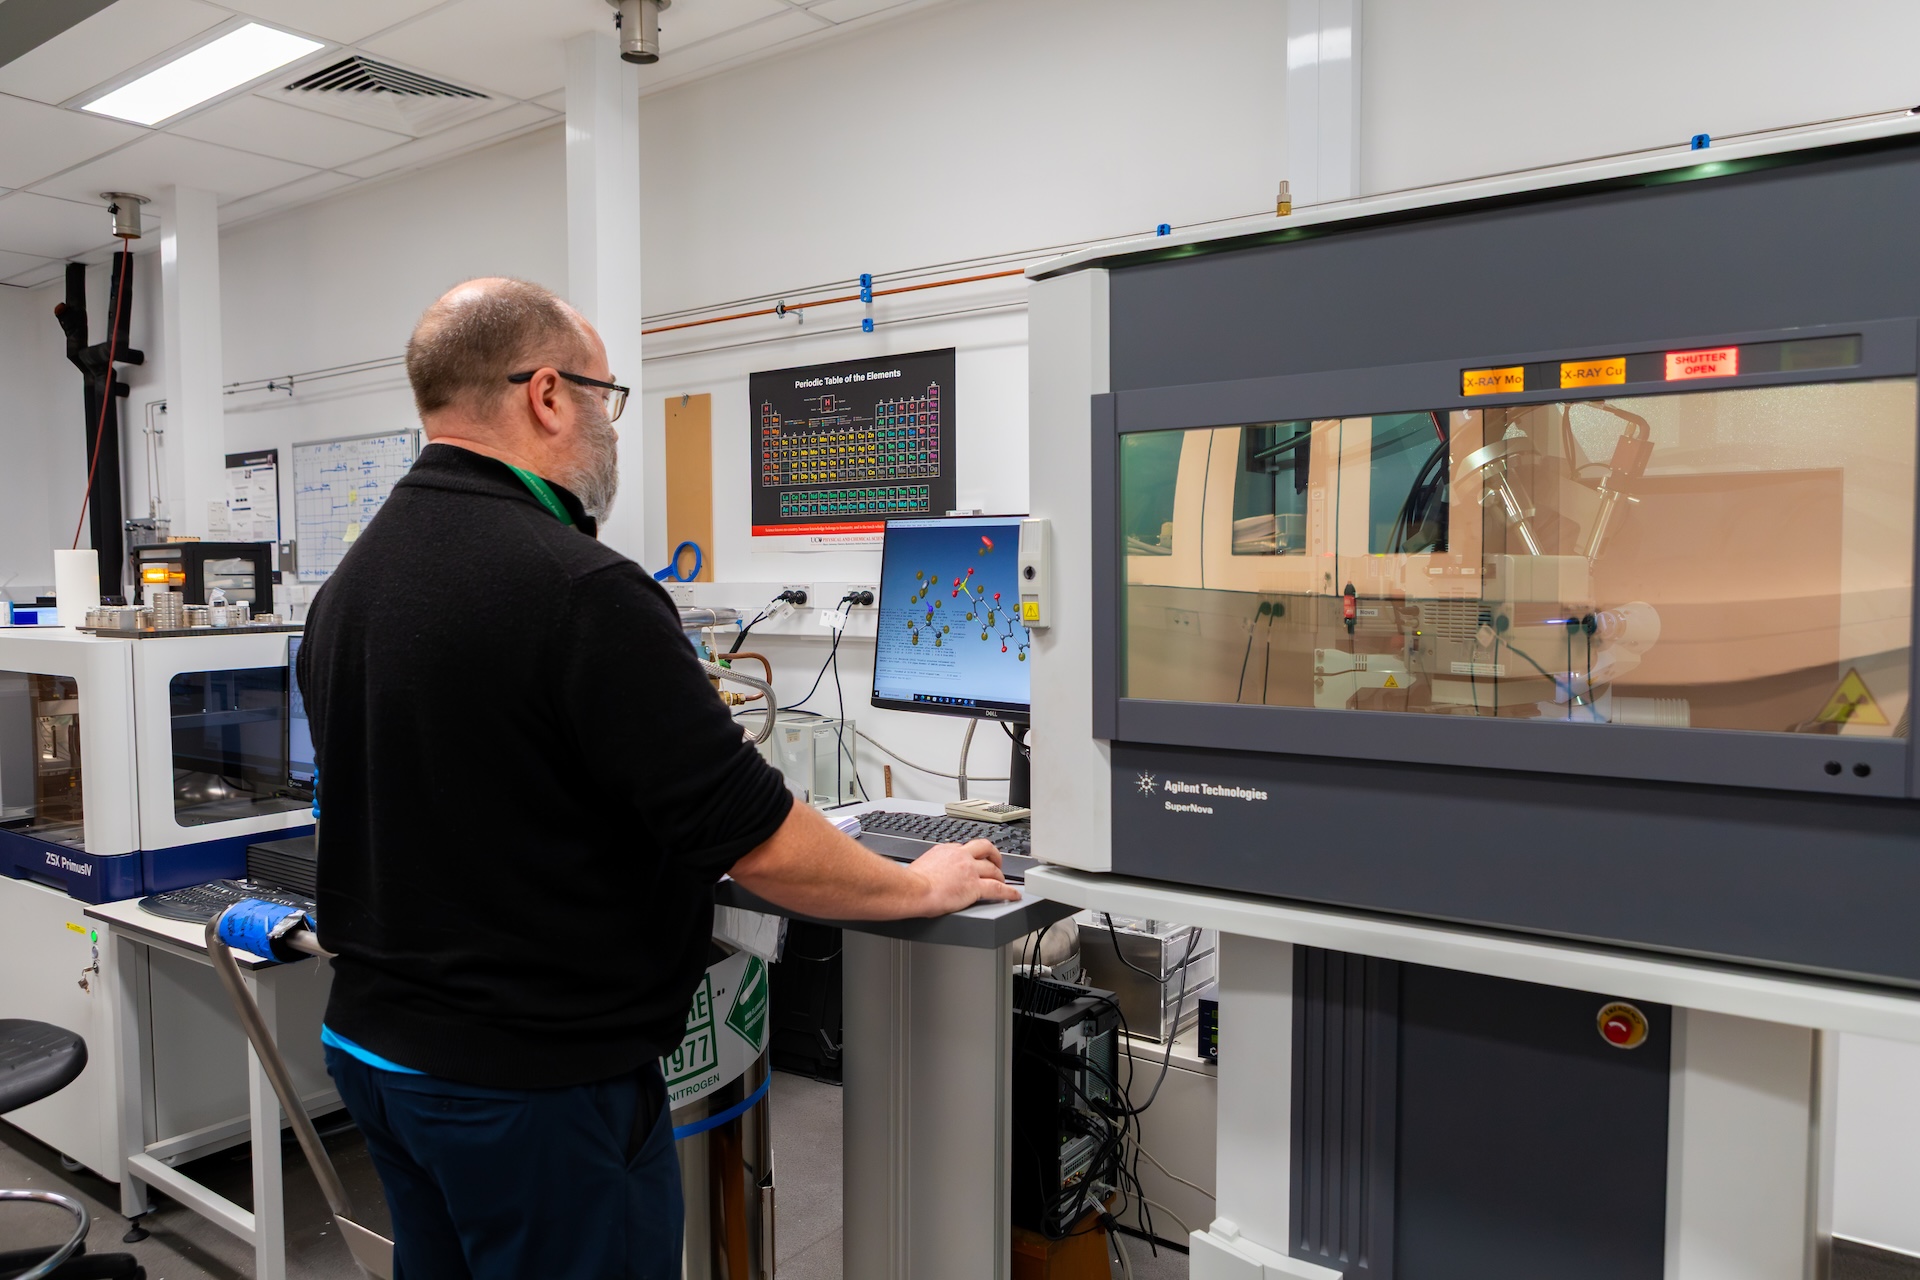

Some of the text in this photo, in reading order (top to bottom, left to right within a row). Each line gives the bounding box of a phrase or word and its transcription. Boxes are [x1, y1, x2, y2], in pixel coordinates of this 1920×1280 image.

[1675, 352, 1726, 364] SHUTTER
[1564, 367, 1622, 379] X-RAY Cu
[1685, 365, 1716, 374] OPEN
[795, 370, 901, 388] Periodic Table of the Elements
[1467, 375, 1522, 387] X-RAY Mo
[1164, 780, 1268, 801] Agilent Technologies
[1165, 801, 1213, 814] SuperNova
[45, 852, 93, 876] ZSX PrimusIV
[669, 1073, 720, 1103] NITROGEN
